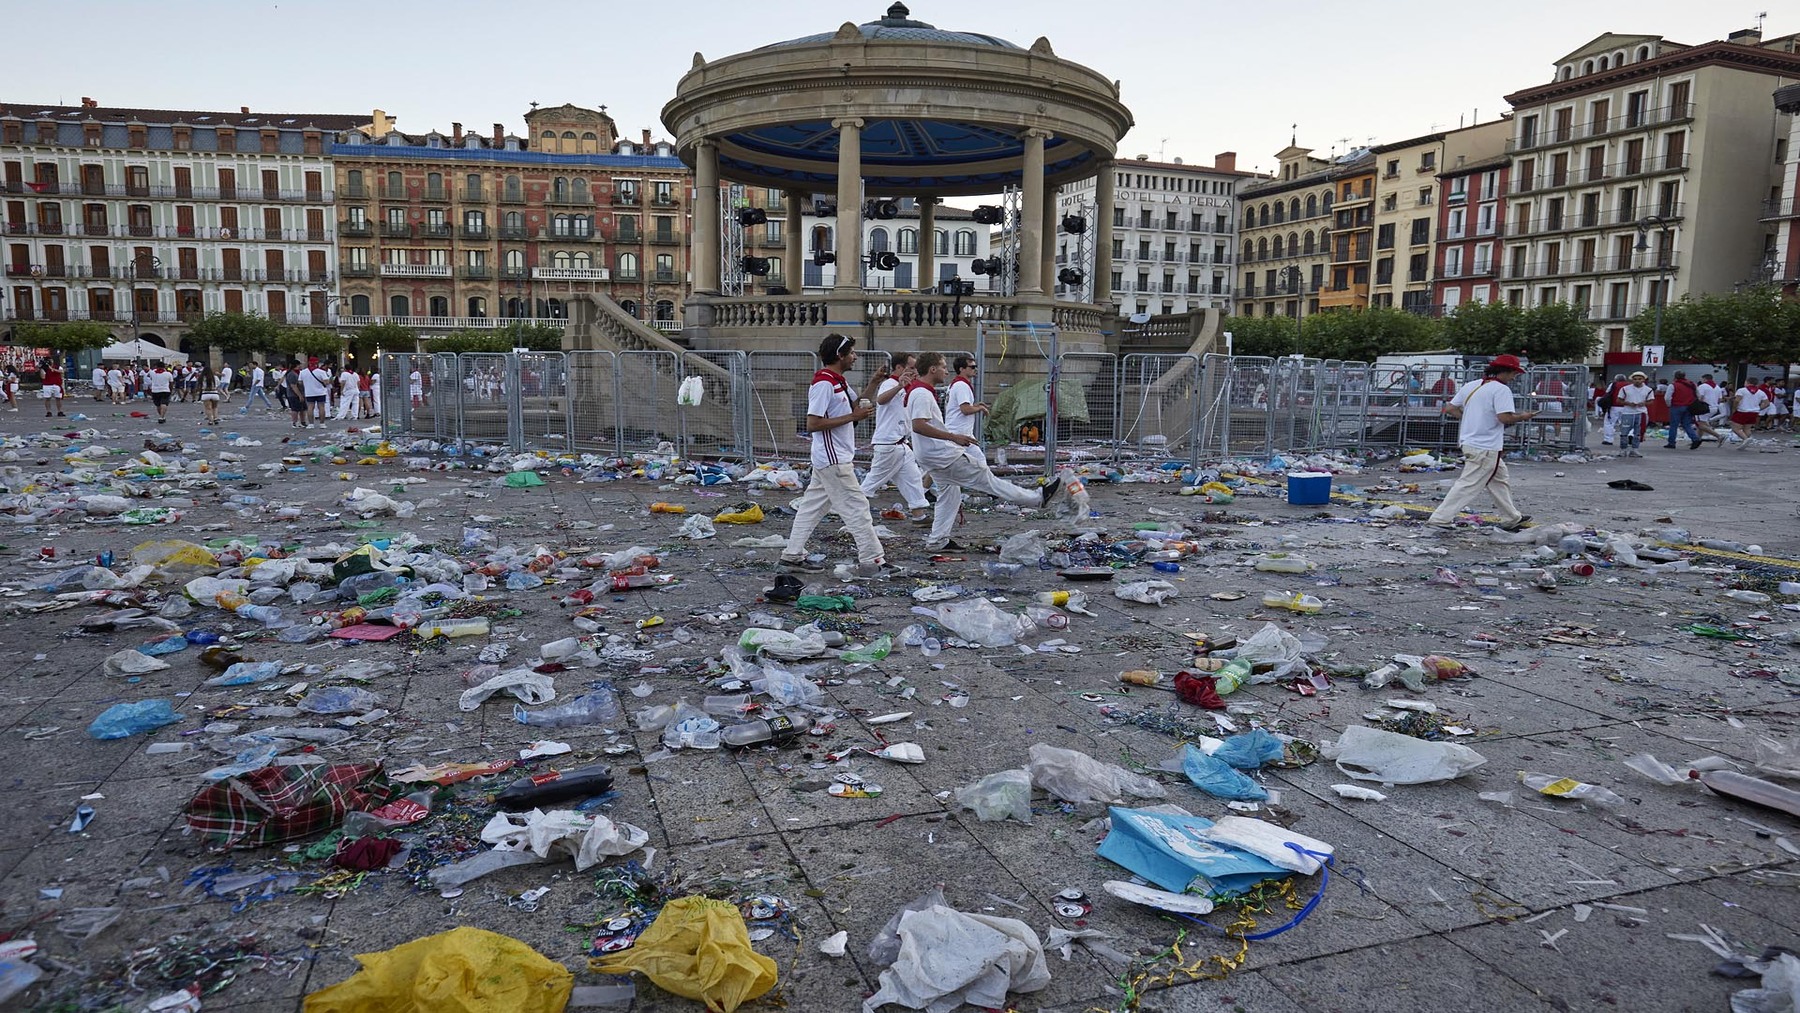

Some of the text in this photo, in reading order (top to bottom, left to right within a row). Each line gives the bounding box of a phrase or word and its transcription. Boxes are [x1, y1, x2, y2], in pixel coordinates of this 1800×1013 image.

[1061, 193, 1087, 207] HOTEL
[1114, 190, 1232, 208] HOTEL LA PERLA
